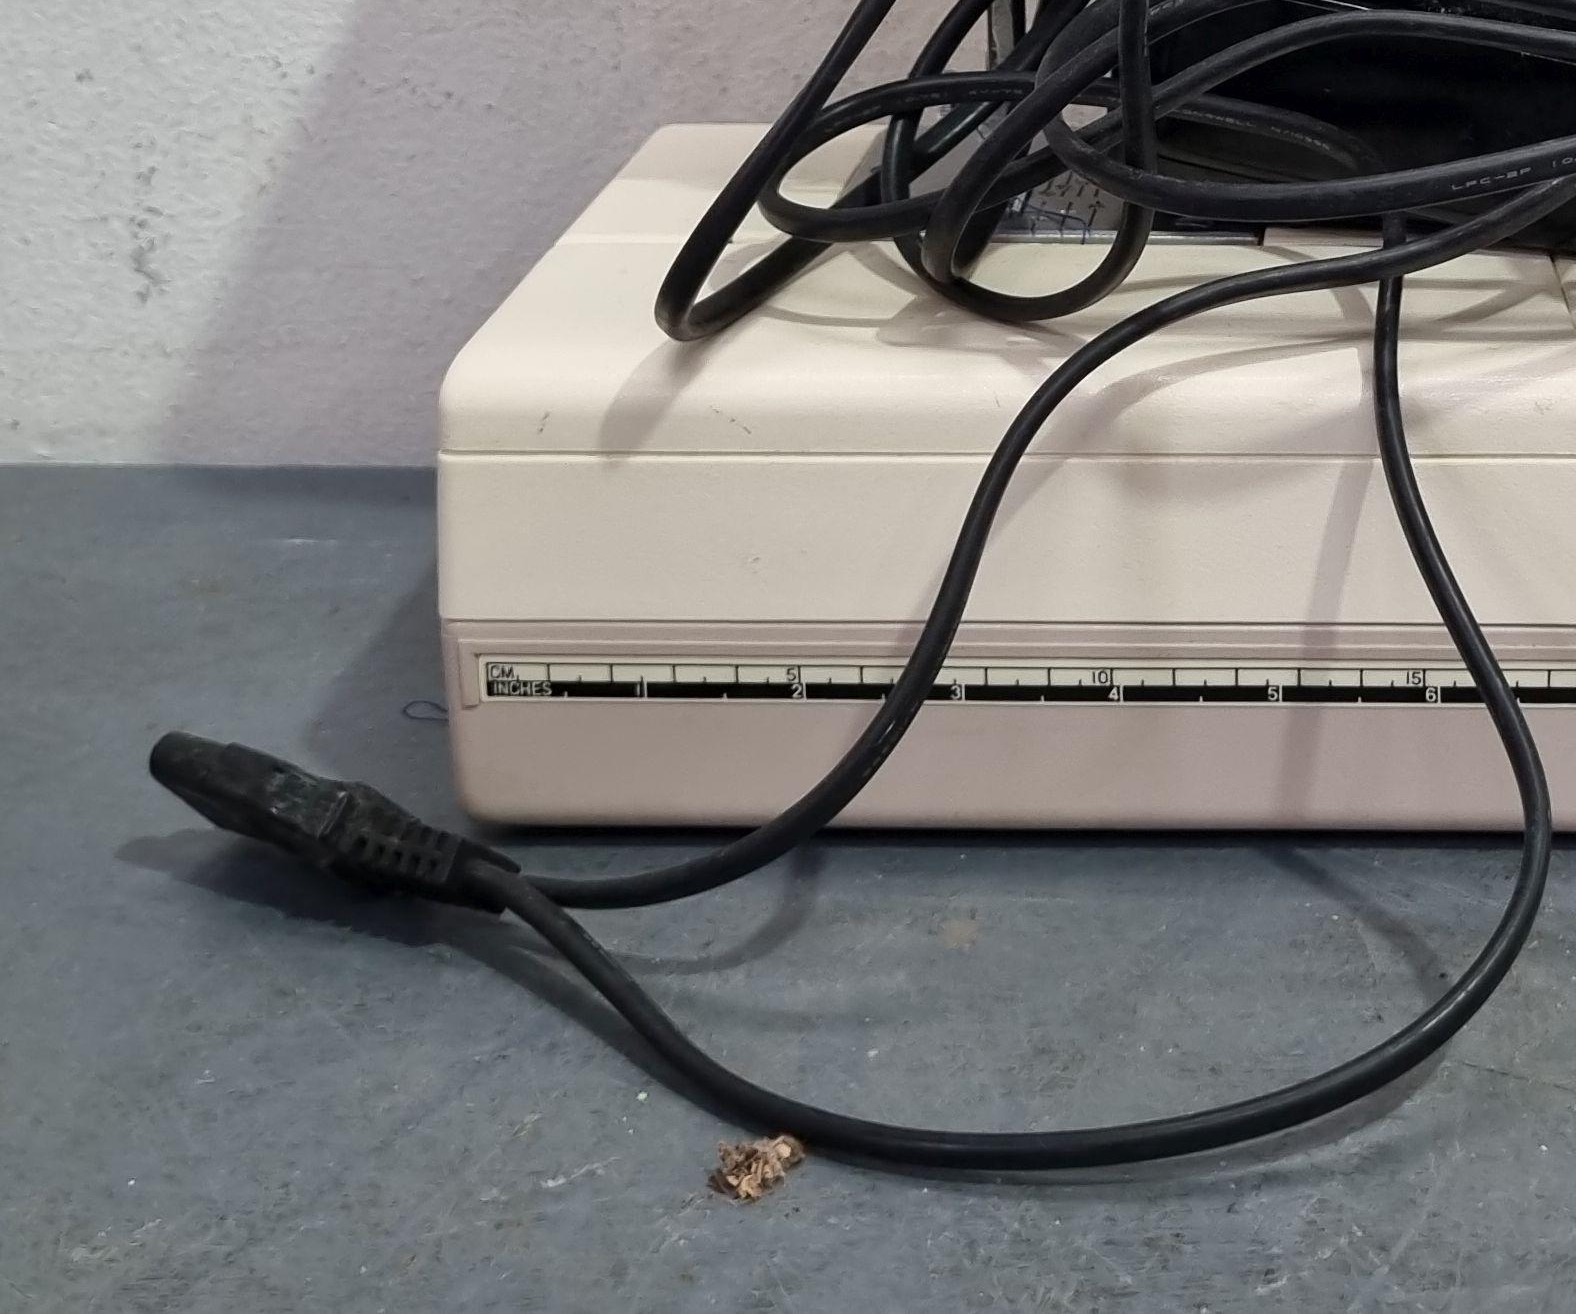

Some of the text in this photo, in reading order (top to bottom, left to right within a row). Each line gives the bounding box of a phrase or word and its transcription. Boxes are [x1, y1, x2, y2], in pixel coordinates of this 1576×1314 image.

[490, 665, 515, 680] CM
[786, 668, 797, 682] 5
[1092, 670, 1109, 685] 10
[1406, 671, 1422, 686] 15
[492, 682, 552, 697] INCHES
[792, 684, 803, 698] 2
[951, 687, 961, 700] 3
[1108, 687, 1119, 701] 4
[1267, 688, 1278, 701] 5
[1425, 688, 1437, 702] 6
